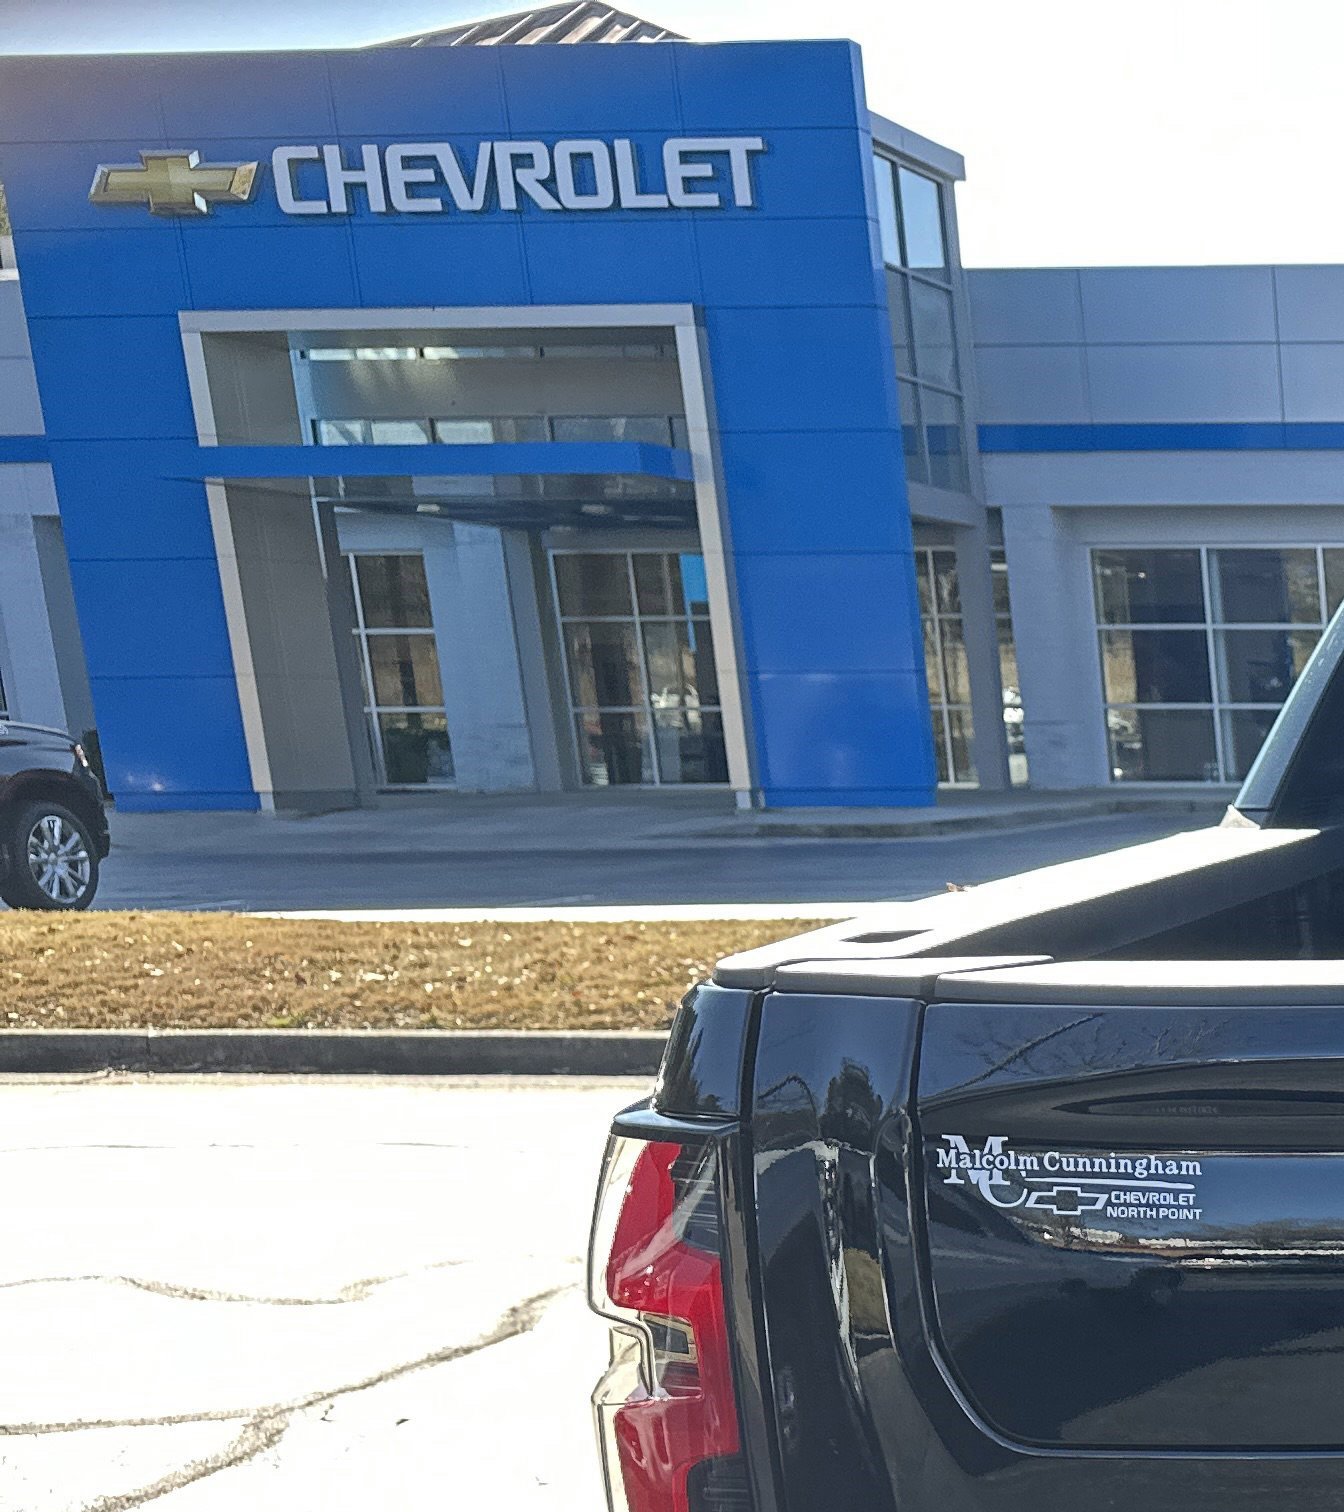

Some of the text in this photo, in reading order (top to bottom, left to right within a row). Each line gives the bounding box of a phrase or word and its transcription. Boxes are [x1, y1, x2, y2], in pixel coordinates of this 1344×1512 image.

[272, 137, 764, 214] CHEVROLET
[936, 1148, 1203, 1178] Malcolm Cunningham
[1111, 1190, 1197, 1206] CHEVROLET
[1106, 1206, 1203, 1220] NORTH POINT
